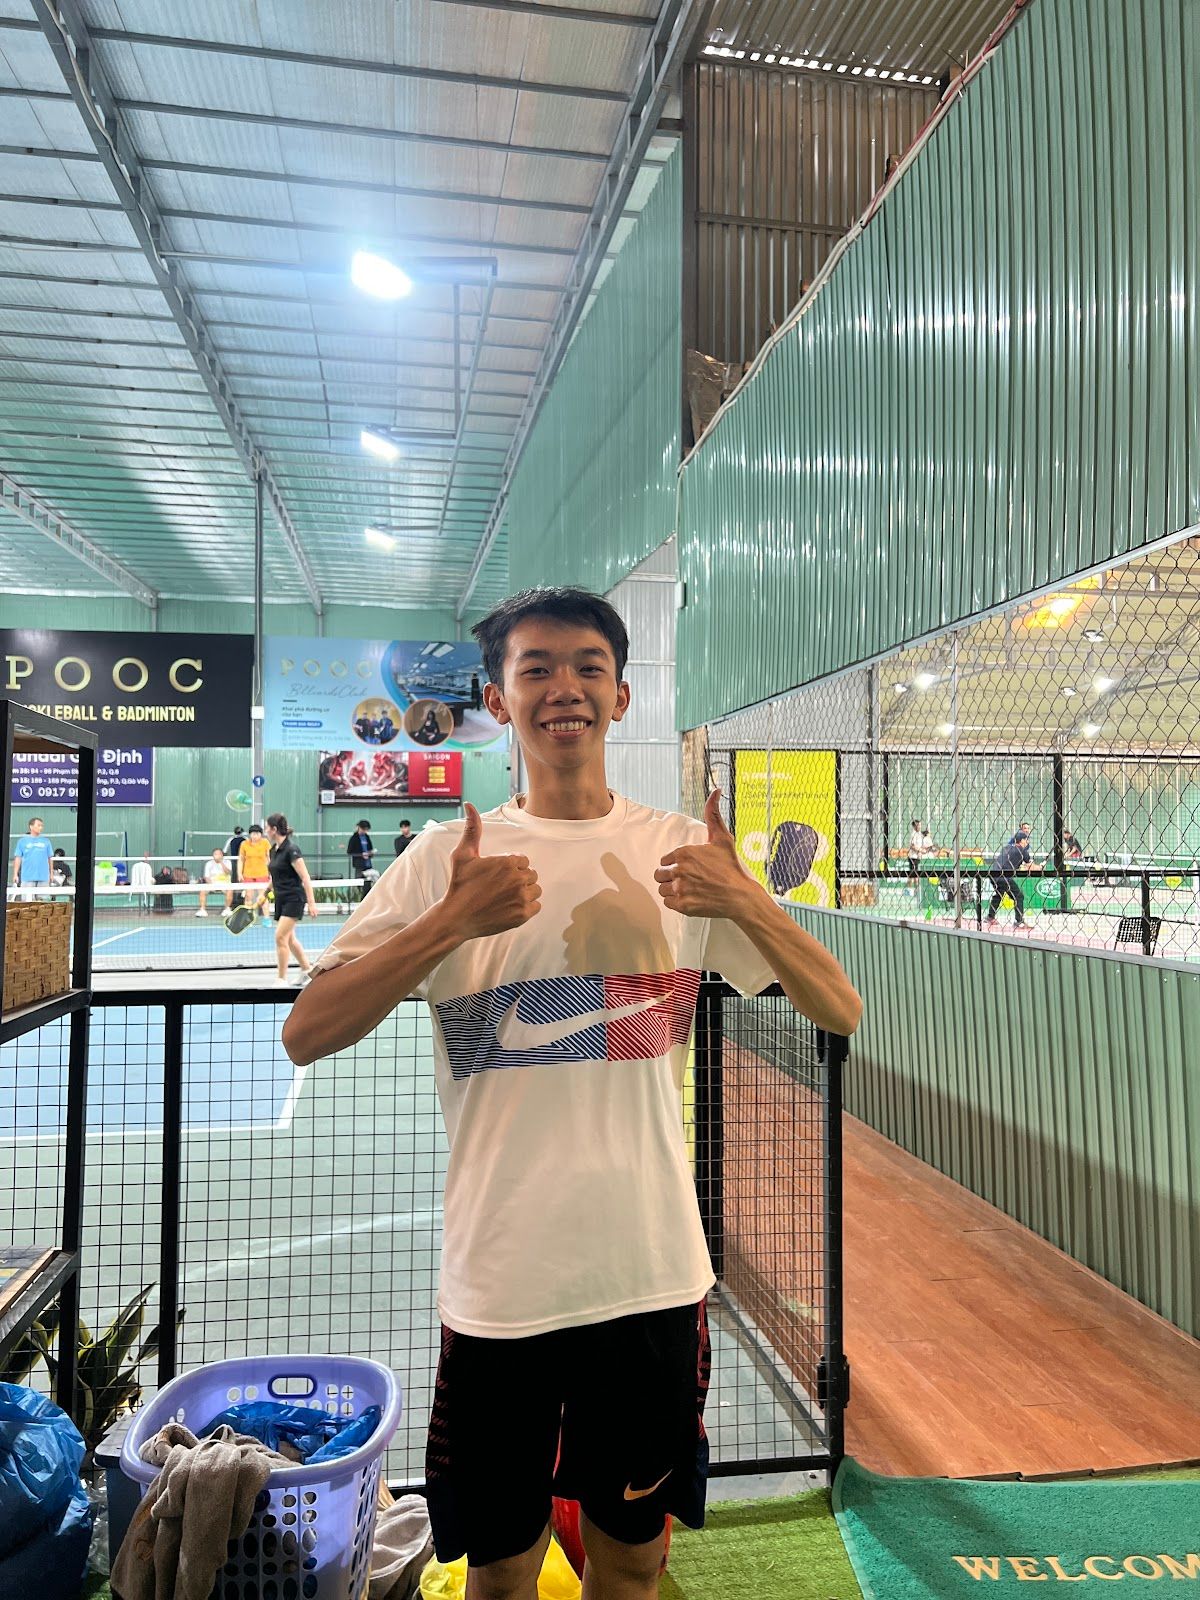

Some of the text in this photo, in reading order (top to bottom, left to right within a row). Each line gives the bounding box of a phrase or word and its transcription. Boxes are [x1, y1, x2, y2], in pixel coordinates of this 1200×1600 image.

[5, 655, 203, 693] POOC
[280, 658, 373, 678] POOC
[102, 705, 113, 721] &
[118, 706, 195, 722] BADMINTON
[103, 748, 143, 766] Định
[38, 786, 65, 797] 0917
[952, 1554, 1200, 1581] WELCOM
